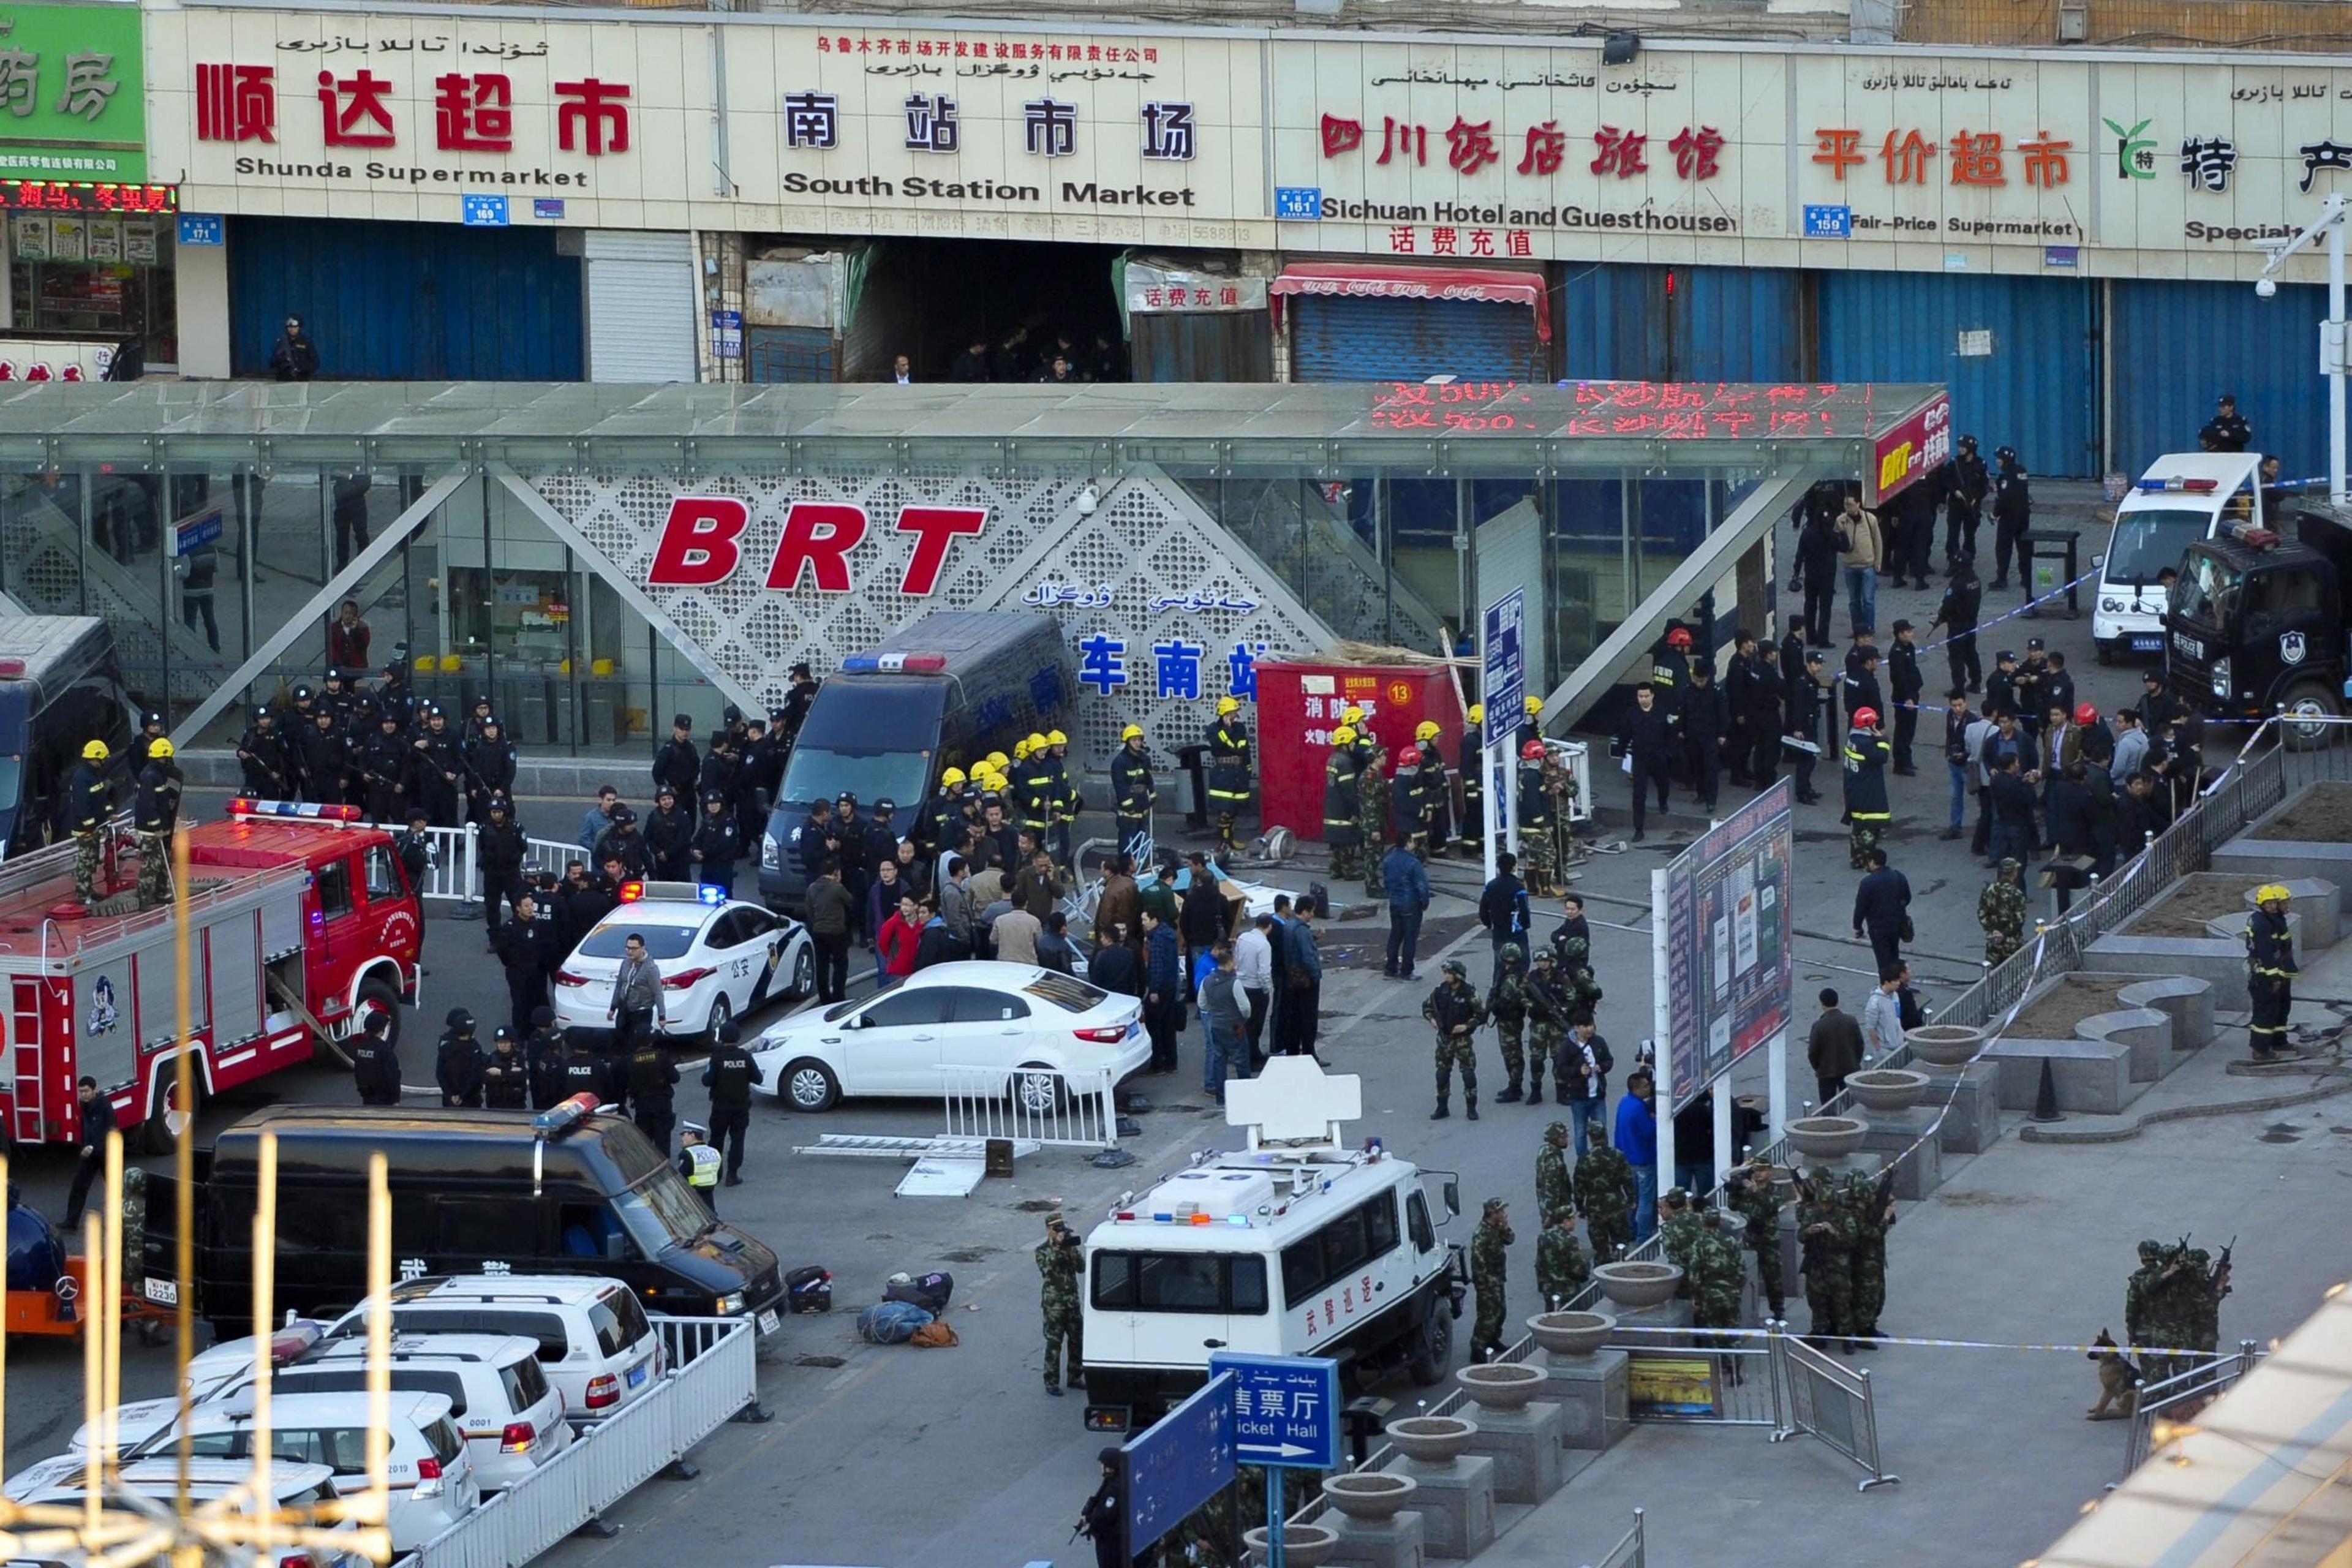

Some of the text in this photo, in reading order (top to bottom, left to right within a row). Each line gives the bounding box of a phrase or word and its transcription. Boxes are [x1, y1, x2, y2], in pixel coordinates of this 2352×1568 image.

[195, 62, 631, 156] 顺达超市
[783, 90, 1197, 161] 南站市场
[1321, 112, 1726, 181] 四川饭店旅馆
[1812, 126, 2073, 189] 平价超市
[235, 157, 588, 187] Shunda Supermarket
[2180, 136, 2352, 193] 特产
[783, 172, 1196, 206] South Station Market
[477, 209, 494, 219] 169
[1287, 202, 1311, 213] 161
[1321, 197, 1728, 233] Sichuan Hotel and Guesthouse
[193, 228, 209, 239] 171
[1816, 219, 1840, 230] 159
[1948, 216, 2073, 236] Supermarket
[1389, 226, 1532, 257] 话费充值
[1144, 287, 1238, 306] 话费充值
[1880, 441, 1912, 491] BRT
[648, 497, 989, 596] BRT
[1391, 685, 1408, 700] 13
[568, 1066, 592, 1075] POLICE
[723, 1060, 746, 1068] POLICE
[148, 1287, 175, 1302] 12230
[1237, 1419, 1317, 1438] icket Hall
